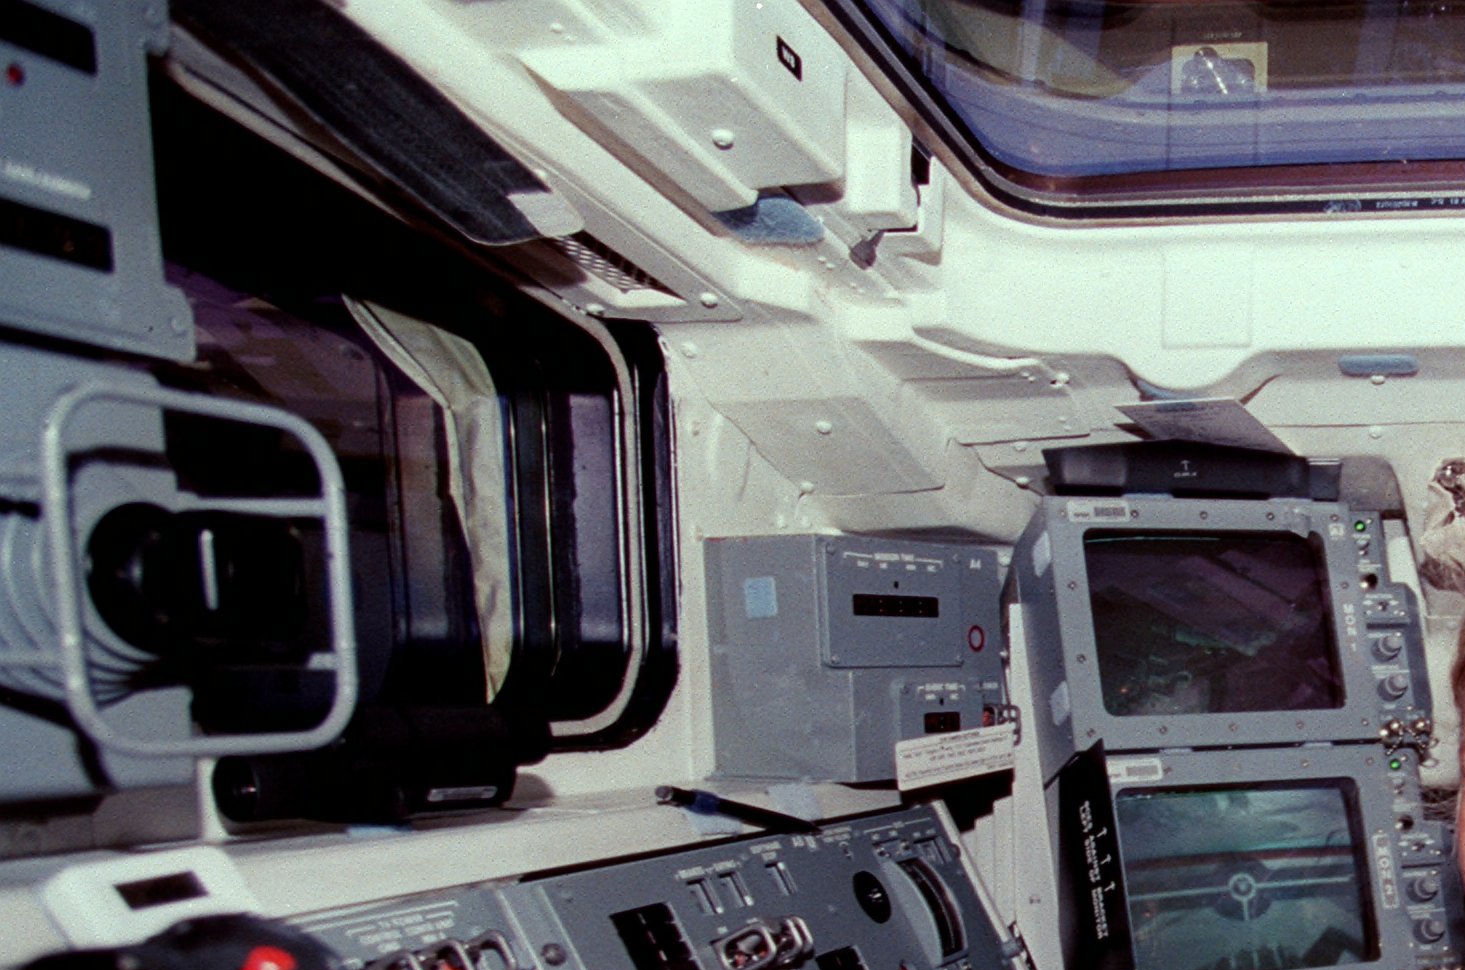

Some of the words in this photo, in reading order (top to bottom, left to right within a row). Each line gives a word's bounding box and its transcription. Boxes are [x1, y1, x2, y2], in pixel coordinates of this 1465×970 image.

[1089, 835, 1101, 881] AGAINST
[1096, 886, 1108, 938] BRACKET
[1092, 889, 1103, 940] MONITOR
